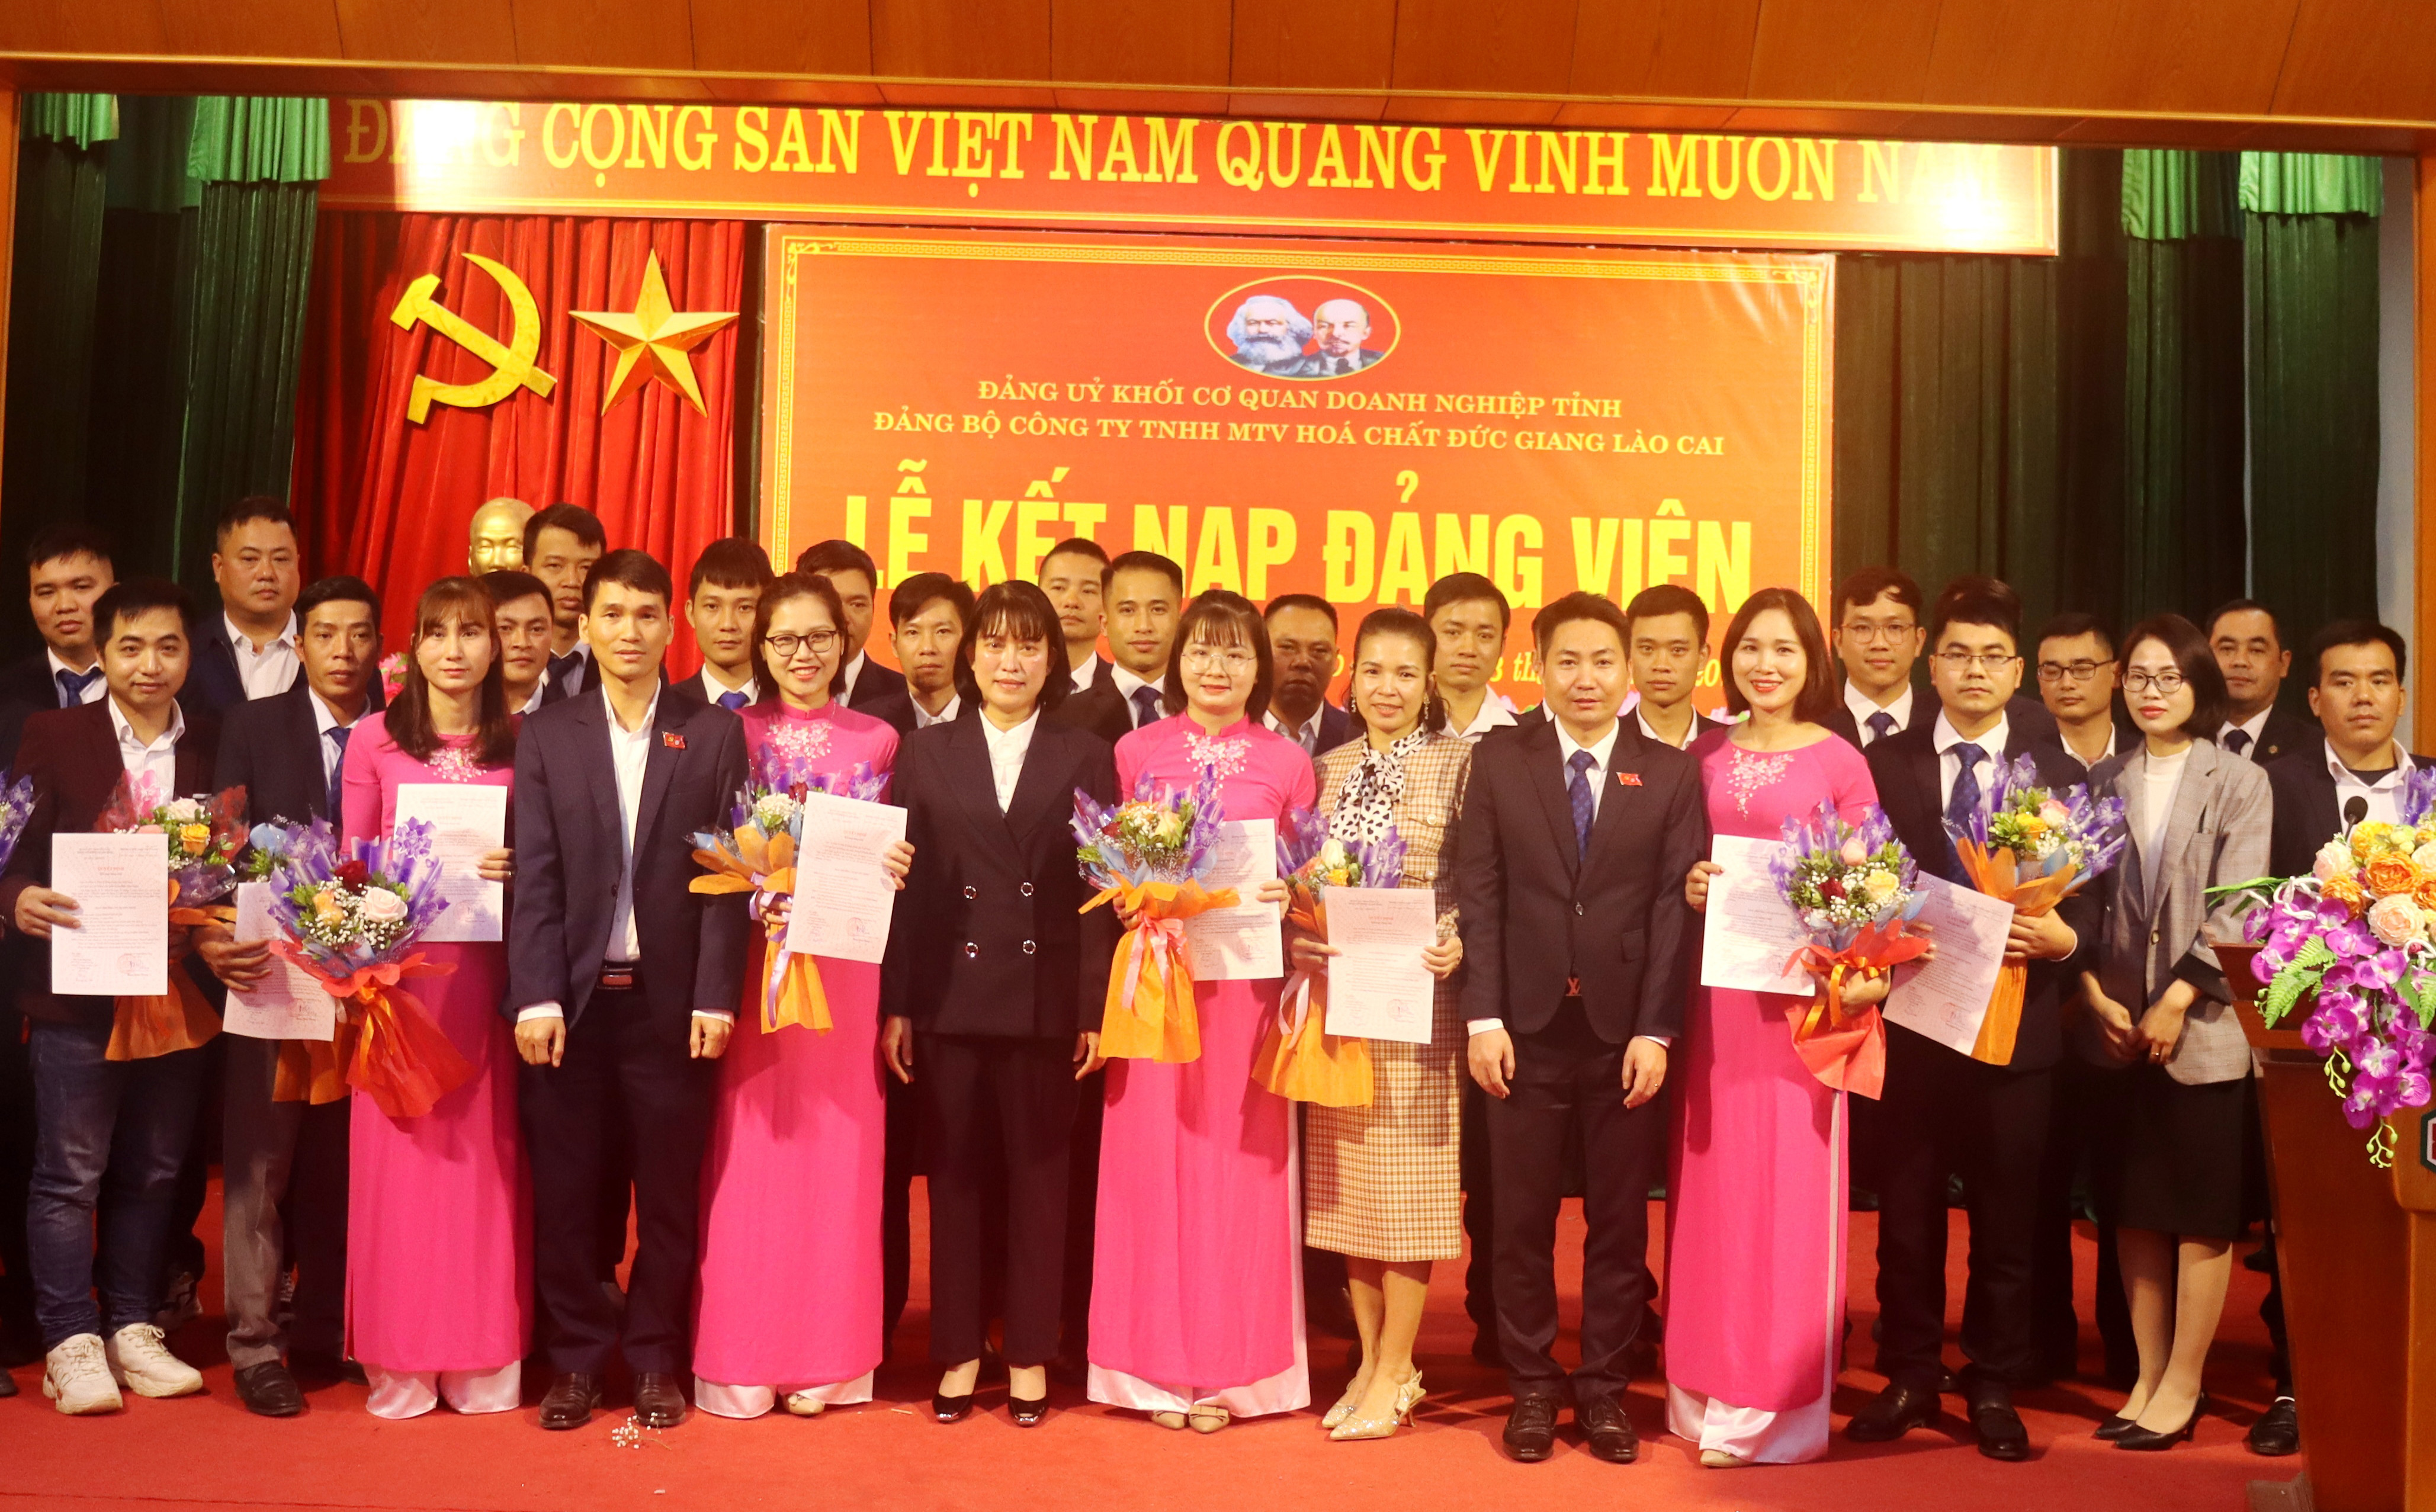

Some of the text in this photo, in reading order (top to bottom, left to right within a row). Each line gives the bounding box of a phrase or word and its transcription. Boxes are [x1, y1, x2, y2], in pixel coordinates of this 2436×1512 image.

[1049, 113, 1199, 185] NAM
[1217, 120, 1447, 192] QUANG
[1465, 129, 1631, 195] VINH
[978, 374, 1622, 419] ĐẢNG UỶ KHỐI CƠ QUAN DOANH NGHIỆP TỈNH
[874, 405, 1724, 455] ĐẢNG BỘ CÔNG TY TNHH MTV HOÁ CHẤT ĐỨC GIANG LÀO CAI
[845, 458, 932, 590] LỄ
[1323, 469, 1543, 609] ĐẢNG
[1571, 499, 1751, 614] VIÊN
